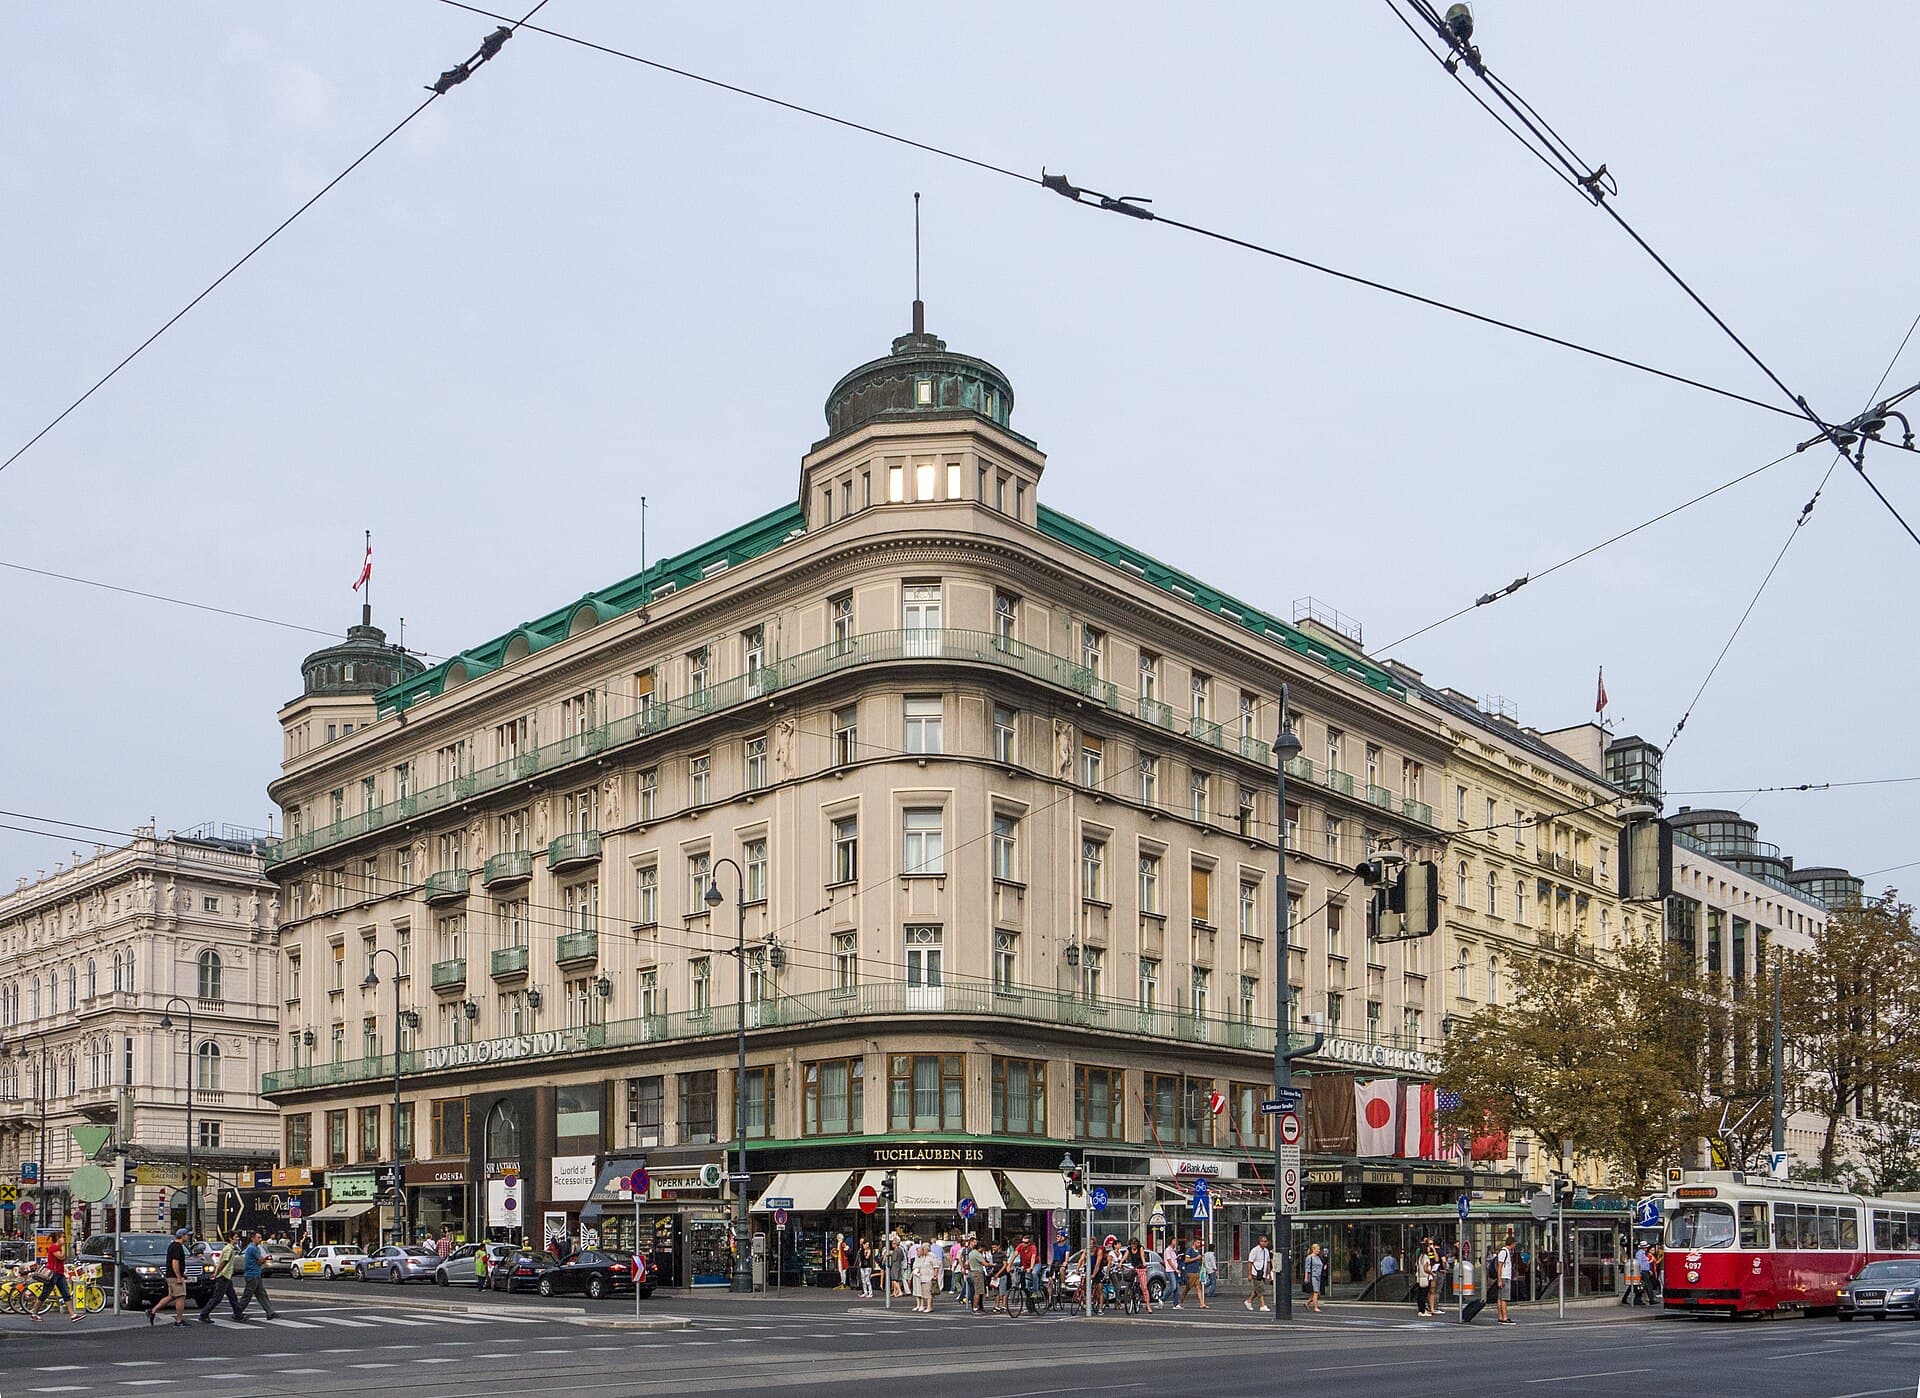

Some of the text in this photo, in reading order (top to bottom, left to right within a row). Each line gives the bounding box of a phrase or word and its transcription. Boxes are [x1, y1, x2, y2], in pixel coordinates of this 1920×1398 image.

[425, 1031, 568, 1069] HOTEL BRISTOL
[1317, 1039, 1372, 1064] HOTEL
[874, 1149, 984, 1161] TUCHLAUBEN EIS
[486, 1163, 496, 1174] SIR
[580, 1166, 587, 1174] of
[1186, 1162, 1219, 1174] Bank Austria
[1287, 1173, 1294, 1182] 30
[1371, 1172, 1396, 1183] HOTEL
[1425, 1174, 1452, 1185] BRISTOL
[1671, 1171, 1680, 1180] 71
[553, 1176, 593, 1185] Accessoires
[657, 1178, 683, 1188] OPERN
[1484, 1177, 1503, 1186] HOTEL
[342, 1189, 367, 1197] PALMERS
[1283, 1204, 1298, 1213] Zone
[1684, 1262, 1702, 1270] 4097
